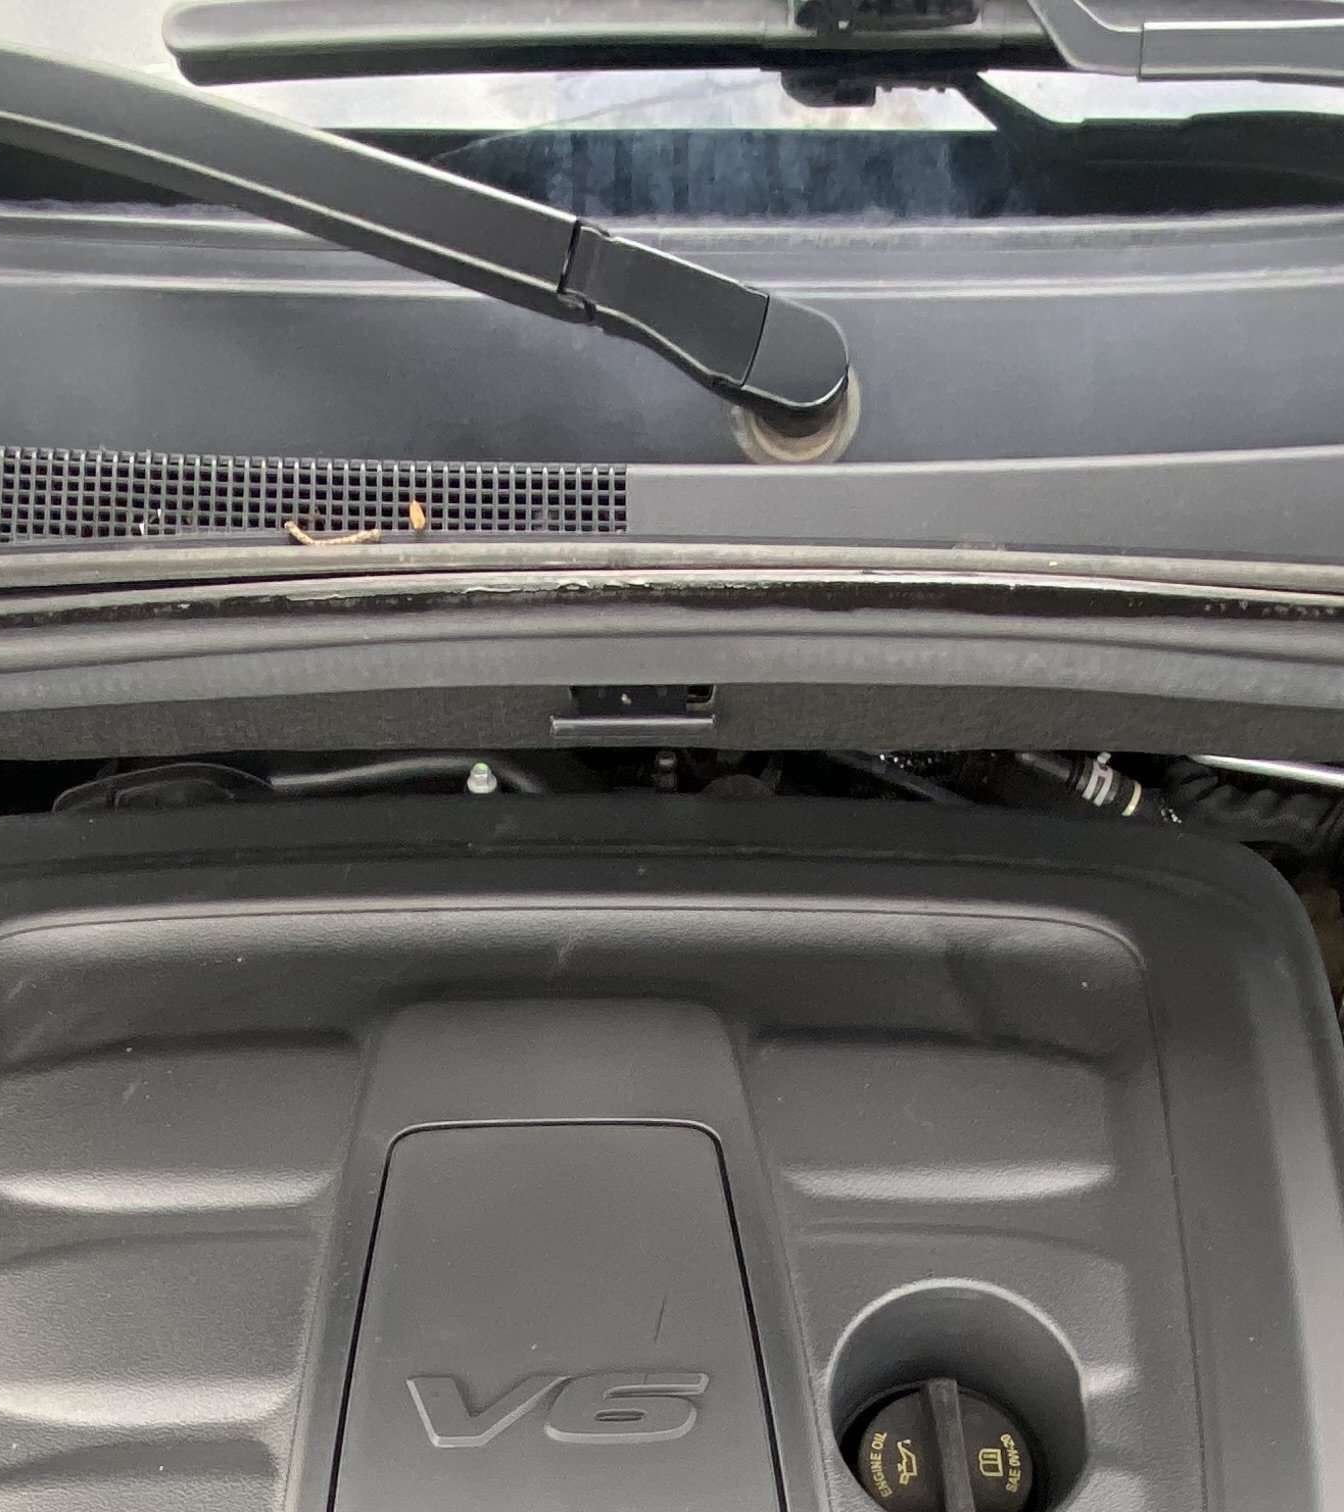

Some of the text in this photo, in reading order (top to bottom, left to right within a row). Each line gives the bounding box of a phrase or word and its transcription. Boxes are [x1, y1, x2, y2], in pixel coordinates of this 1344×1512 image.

[406, 1369, 710, 1448] V6
[870, 1432, 893, 1498] ENGINE OIL
[1006, 1469, 1021, 1493] SAE
